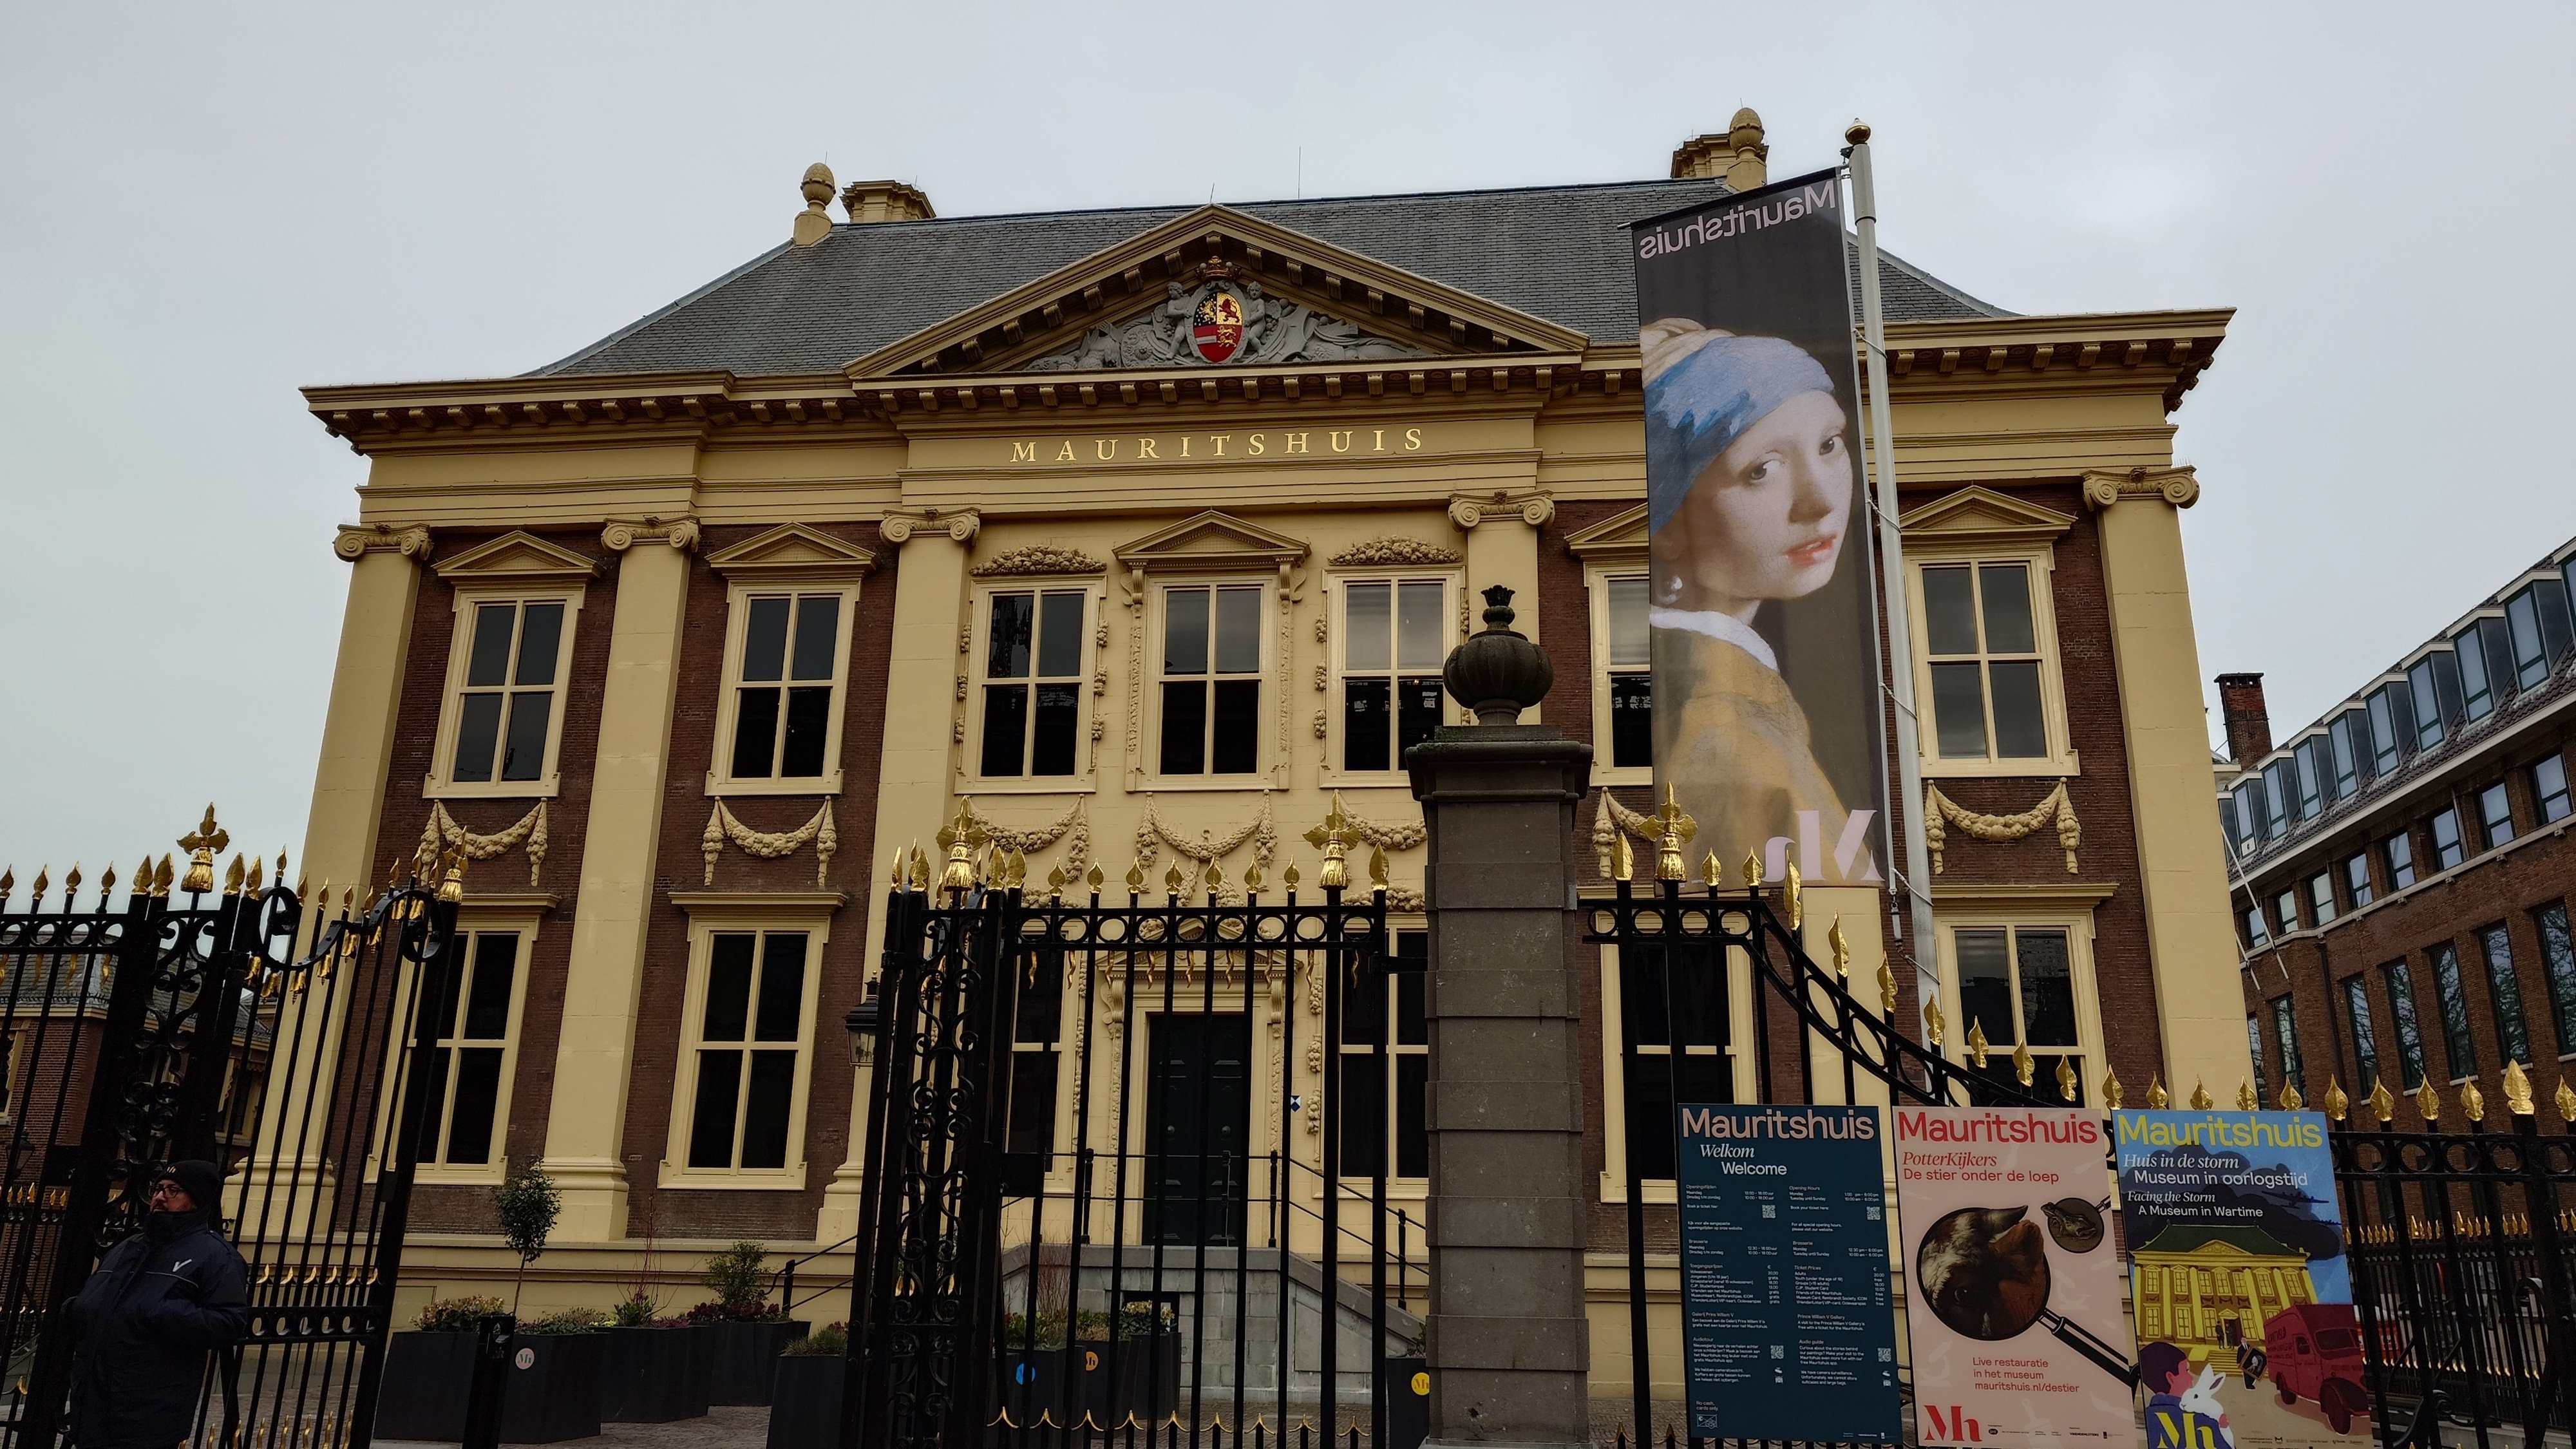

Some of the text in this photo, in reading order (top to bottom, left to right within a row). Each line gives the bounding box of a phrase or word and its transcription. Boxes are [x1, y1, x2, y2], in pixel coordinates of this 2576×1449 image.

[1009, 428, 1422, 462] MAURITSHUIS
[1682, 1108, 1875, 1141] Mauritshuis
[1898, 1112, 2098, 1144] Mauritshuis
[2117, 1115, 2323, 1148] Mauritshuis
[1700, 1144, 1755, 1159] Welkom
[1902, 1151, 1997, 1169] PotterKijkers
[1721, 1161, 1787, 1176] Welcome
[2123, 1153, 2239, 1170] Huis in de storm
[1904, 1169, 2060, 1185] De stier onder de loep
[2134, 1170, 2308, 1189] Museum in oorlogstijd
[2127, 1191, 2215, 1204] Facing the Storm
[2138, 1205, 2263, 1218] A Museum in Wartime
[1973, 1357, 2049, 1368] Live restauratie
[1973, 1369, 1982, 1378] in
[1984, 1370, 2001, 1379] het
[1975, 1381, 2079, 1393] mauritshuis.nl/destier
[1924, 1405, 1983, 1442] Mh
[2155, 1412, 2217, 1449] Mh
